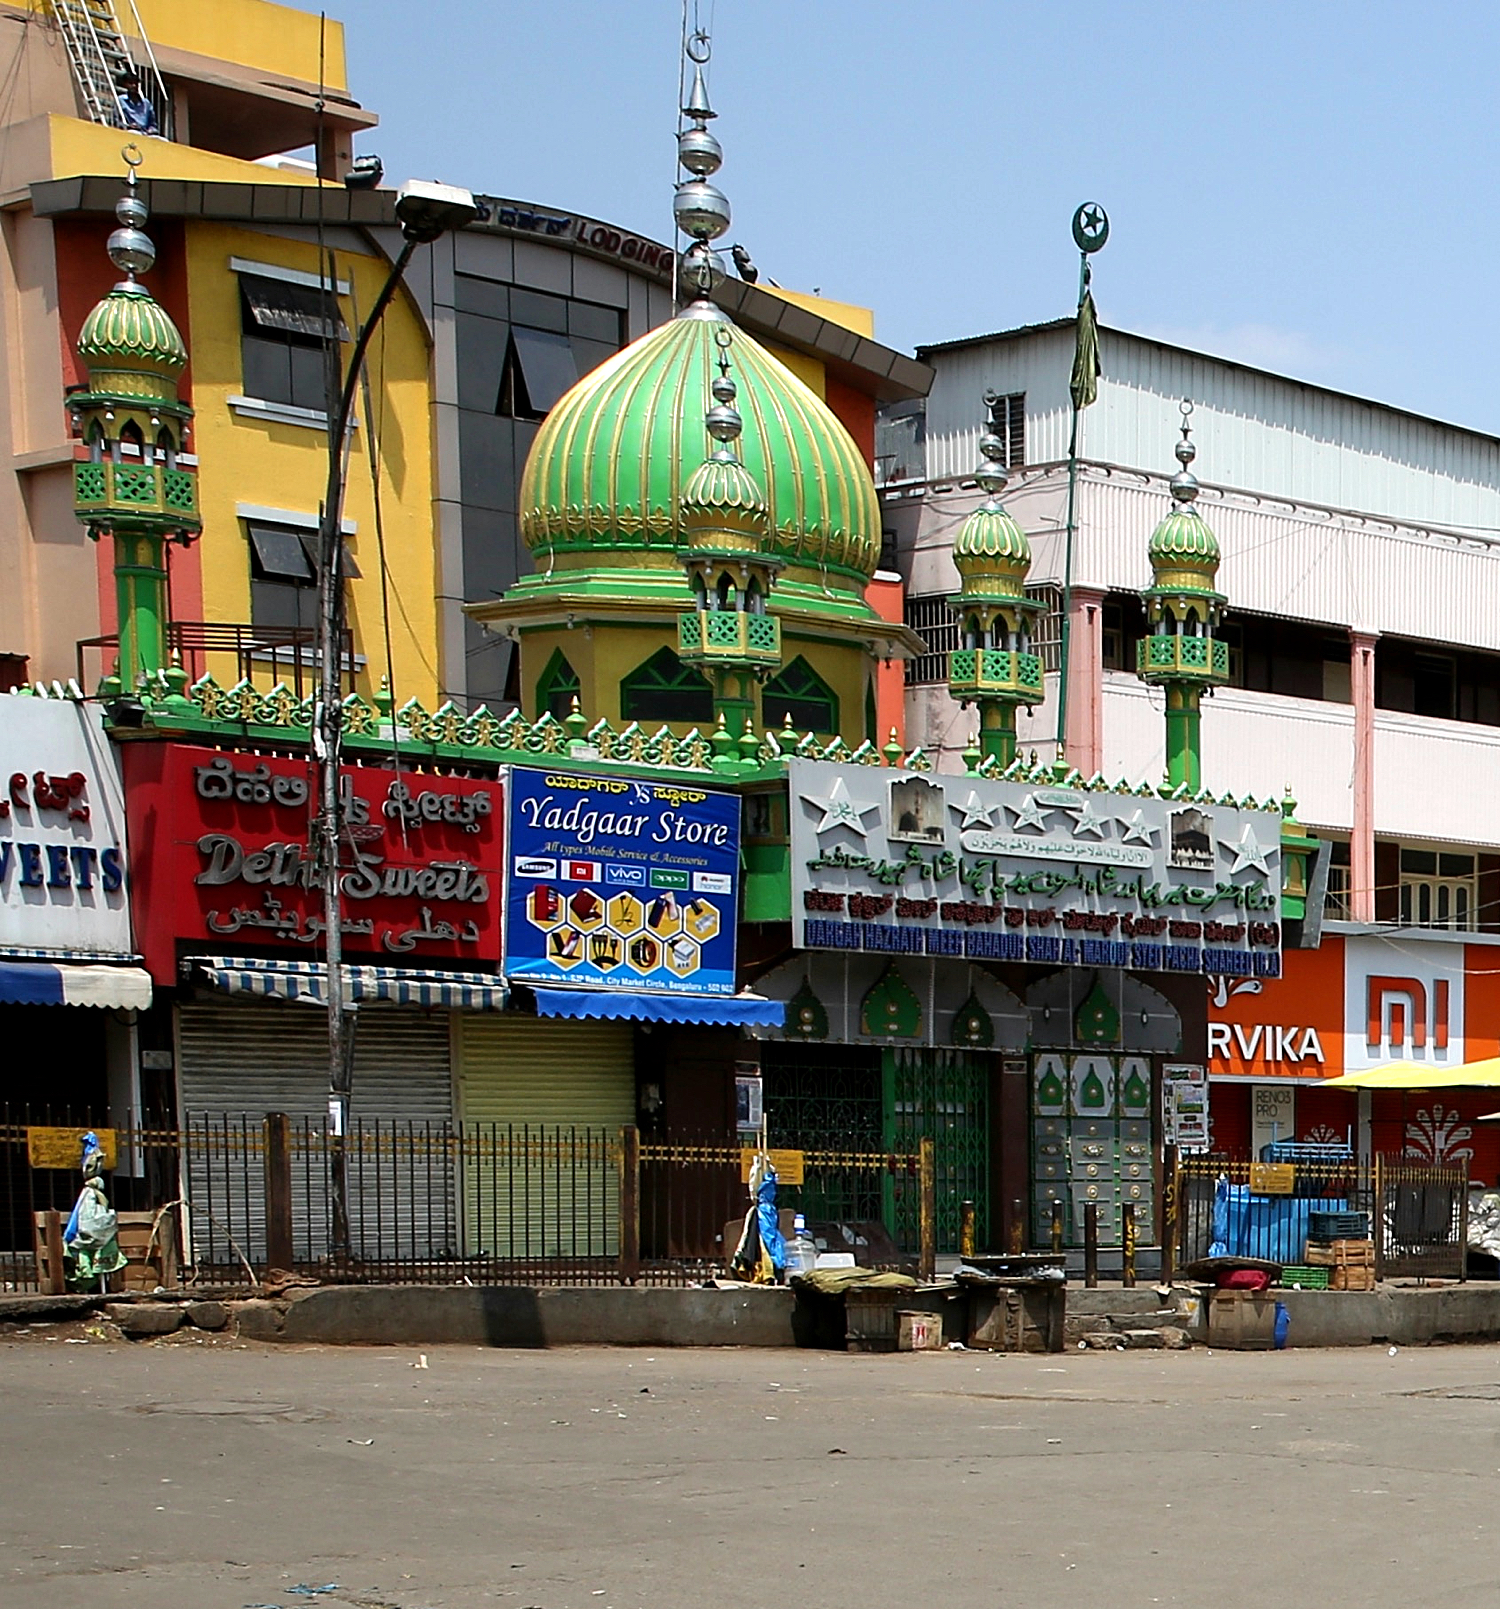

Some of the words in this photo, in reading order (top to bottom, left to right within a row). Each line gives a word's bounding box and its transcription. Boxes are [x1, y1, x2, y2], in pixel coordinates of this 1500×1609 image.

[577, 221, 673, 272] LODGING
[521, 796, 650, 843] Yadgaar
[652, 811, 728, 846] Store
[585, 845, 615, 859] Mobile
[618, 848, 648, 861] Service
[340, 853, 490, 902] Sweets
[609, 867, 642, 880] vivo
[804, 920, 861, 949] DARGAH
[862, 922, 924, 952] HAZRATH
[925, 928, 963, 957] MEER
[964, 930, 1025, 960] BAHADUR
[1026, 935, 1061, 963] SHAH
[1162, 945, 1201, 973] PACHA
[1202, 948, 1252, 976] SHAHEED
[621, 978, 645, 987] Market
[1256, 1090, 1291, 1104] RENO3
[1256, 1104, 1278, 1117] PRO
